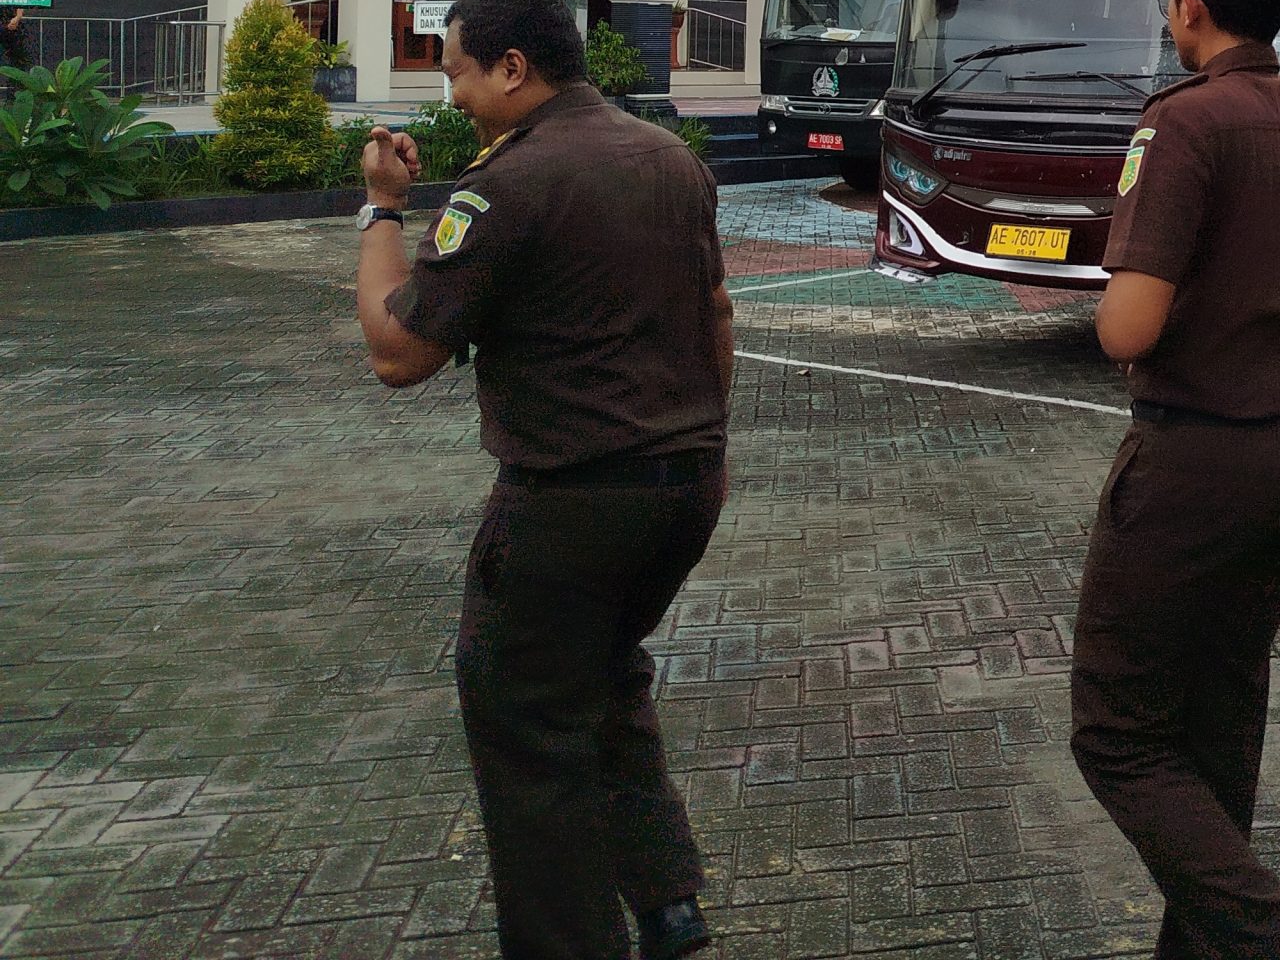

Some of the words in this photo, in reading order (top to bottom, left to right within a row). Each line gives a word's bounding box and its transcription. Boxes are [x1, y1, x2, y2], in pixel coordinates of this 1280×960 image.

[420, 6, 448, 17] KHUSUS
[420, 19, 436, 29] DAN
[991, 227, 1009, 245] AE
[1013, 228, 1046, 248] 7607
[1050, 231, 1069, 249] UT
